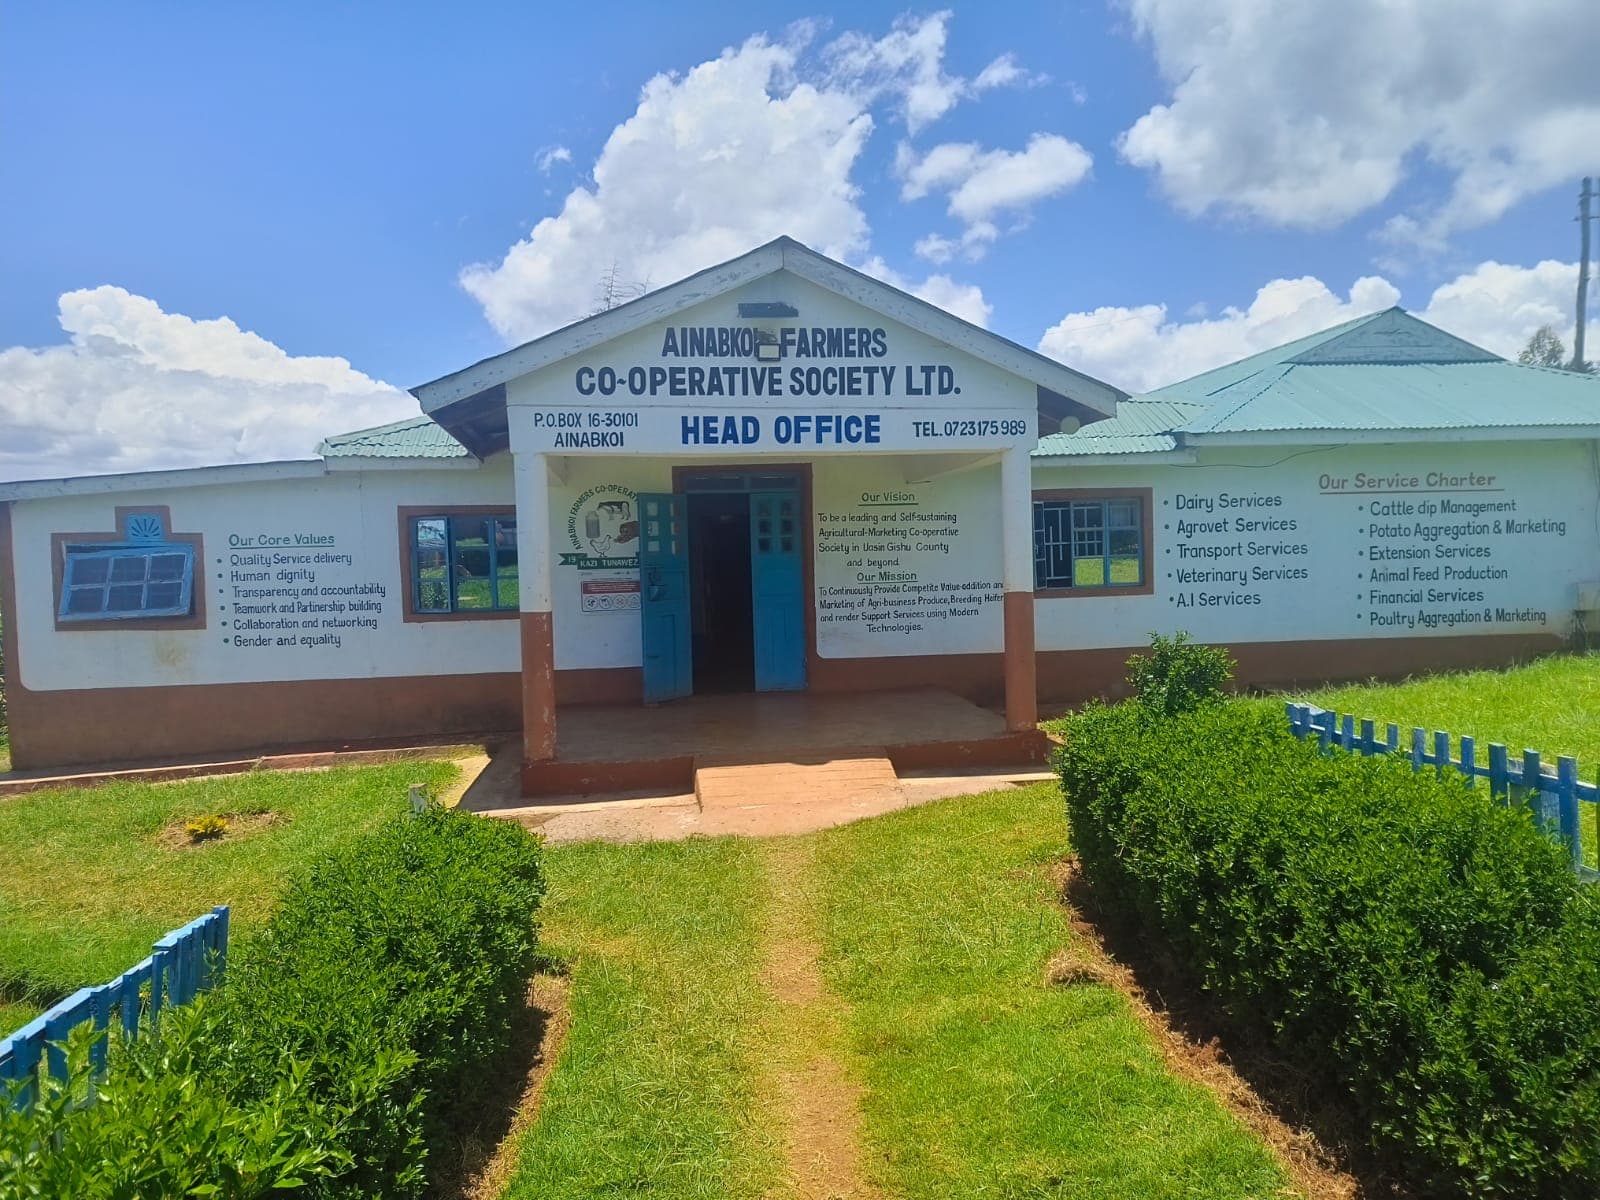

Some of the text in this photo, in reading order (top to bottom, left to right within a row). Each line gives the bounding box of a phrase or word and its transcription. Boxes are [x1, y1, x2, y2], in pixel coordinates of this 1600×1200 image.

[662, 327, 888, 358] AINABKOI FARMERS
[789, 365, 897, 396] SOCIETY
[905, 365, 962, 396] LTD.
[587, 412, 639, 428] 16-30101
[680, 414, 881, 445] HEAD OFFICE
[554, 431, 625, 448] AINABKOI
[1319, 472, 1496, 489] Our Service Charter
[862, 492, 915, 502] Our Vision
[1176, 492, 1282, 513] Dairy Services
[1370, 499, 1516, 517] Cattle dip Management
[818, 513, 827, 522] To
[830, 512, 839, 521] be
[848, 513, 878, 525] leading
[881, 513, 896, 521] and
[900, 512, 957, 523] Self-sustaining
[909, 527, 959, 538] Co-operative
[1177, 516, 1297, 538] Agrovet Services
[1370, 519, 1566, 542] Potato Aggregation & Marketing
[228, 533, 335, 547] Our Core Values
[818, 542, 949, 554] Society in Uasin Gishu County
[1177, 541, 1308, 560] Transport Services
[1370, 544, 1491, 560] Extension Services
[230, 552, 352, 567] Quality Service delivery
[847, 557, 899, 569] and beyond
[230, 569, 315, 584] Human dignity
[856, 571, 917, 581] Our Mission
[1176, 565, 1308, 586] Veterinary Services
[1370, 566, 1508, 583] Animal Feed Production
[232, 583, 386, 599] Transparency and accountability
[819, 587, 827, 597] To
[828, 585, 872, 597] Continuously
[874, 584, 900, 594] Provide
[1370, 588, 1484, 605] Financial Services
[232, 602, 277, 614] Teamwork
[279, 602, 295, 613] and
[348, 600, 382, 614] building
[820, 599, 855, 610] Marketing
[857, 598, 865, 608] of
[950, 595, 982, 605] Breeding
[1176, 591, 1261, 608] A.I Services
[233, 616, 377, 630] Collaboration and networking
[820, 608, 979, 622] and render Support Services using Modern
[1370, 608, 1546, 628] Poultry Aggregation & Marketing
[866, 623, 923, 634] Technologies.
[234, 634, 341, 649] Gender and equality
